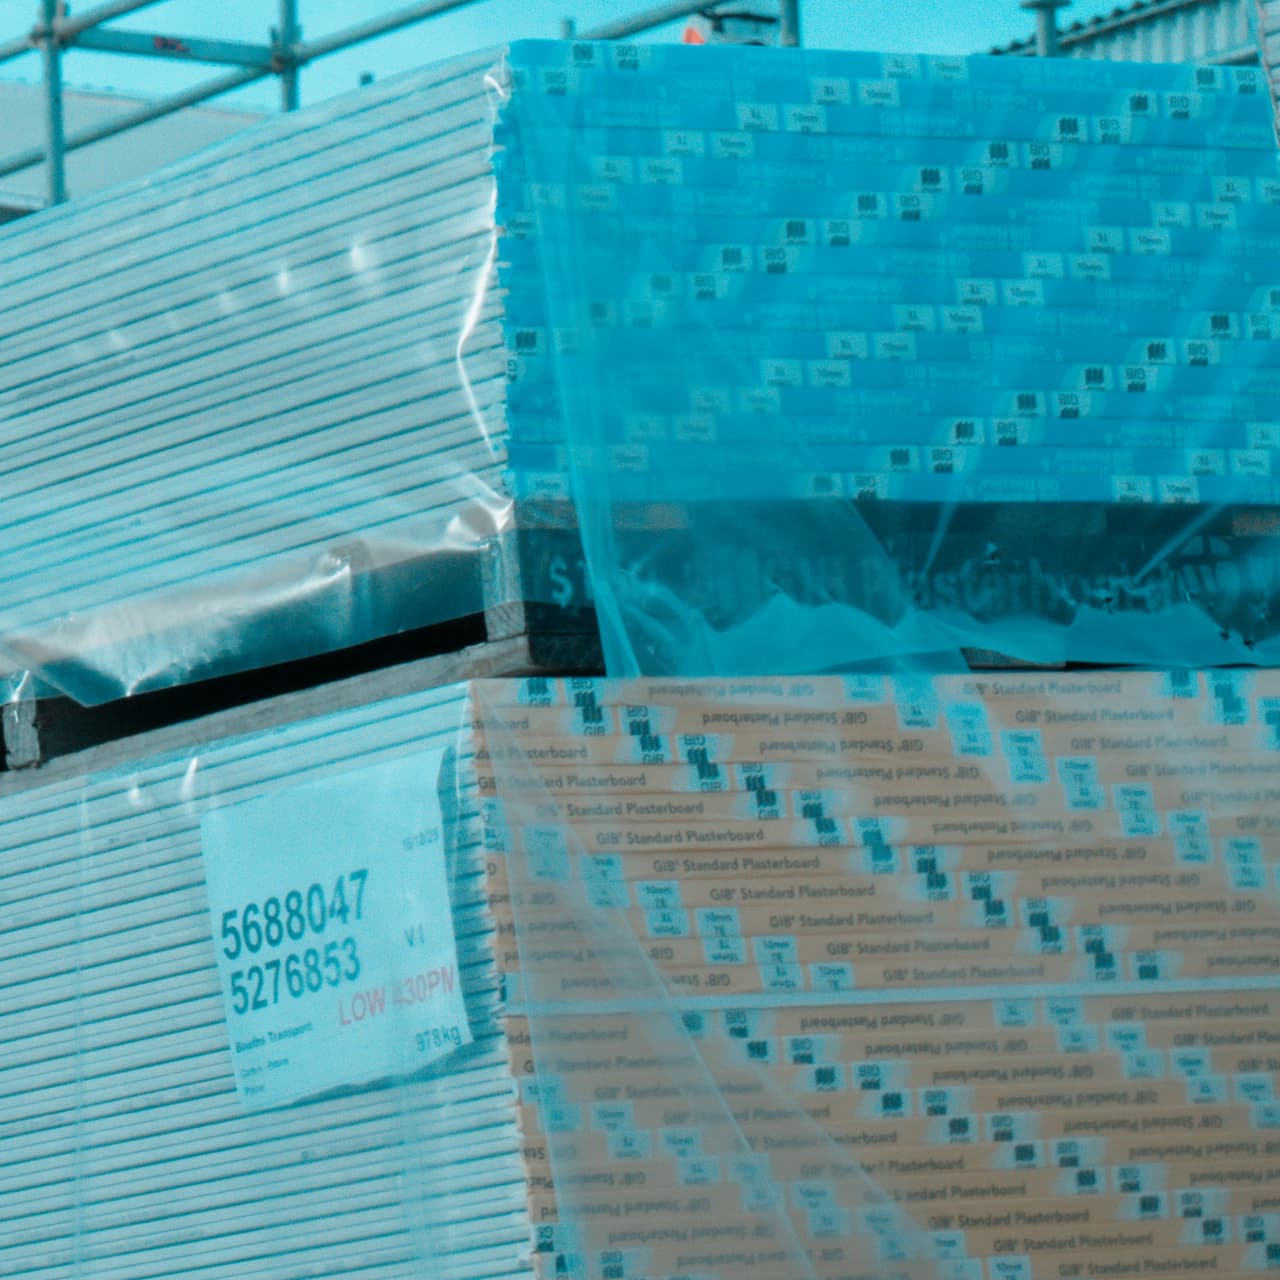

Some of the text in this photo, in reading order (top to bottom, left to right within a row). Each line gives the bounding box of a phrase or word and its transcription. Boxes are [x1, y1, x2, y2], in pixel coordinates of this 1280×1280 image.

[220, 868, 368, 961] 5688047
[229, 937, 361, 1016] 5276853
[337, 985, 387, 1026] LOW
